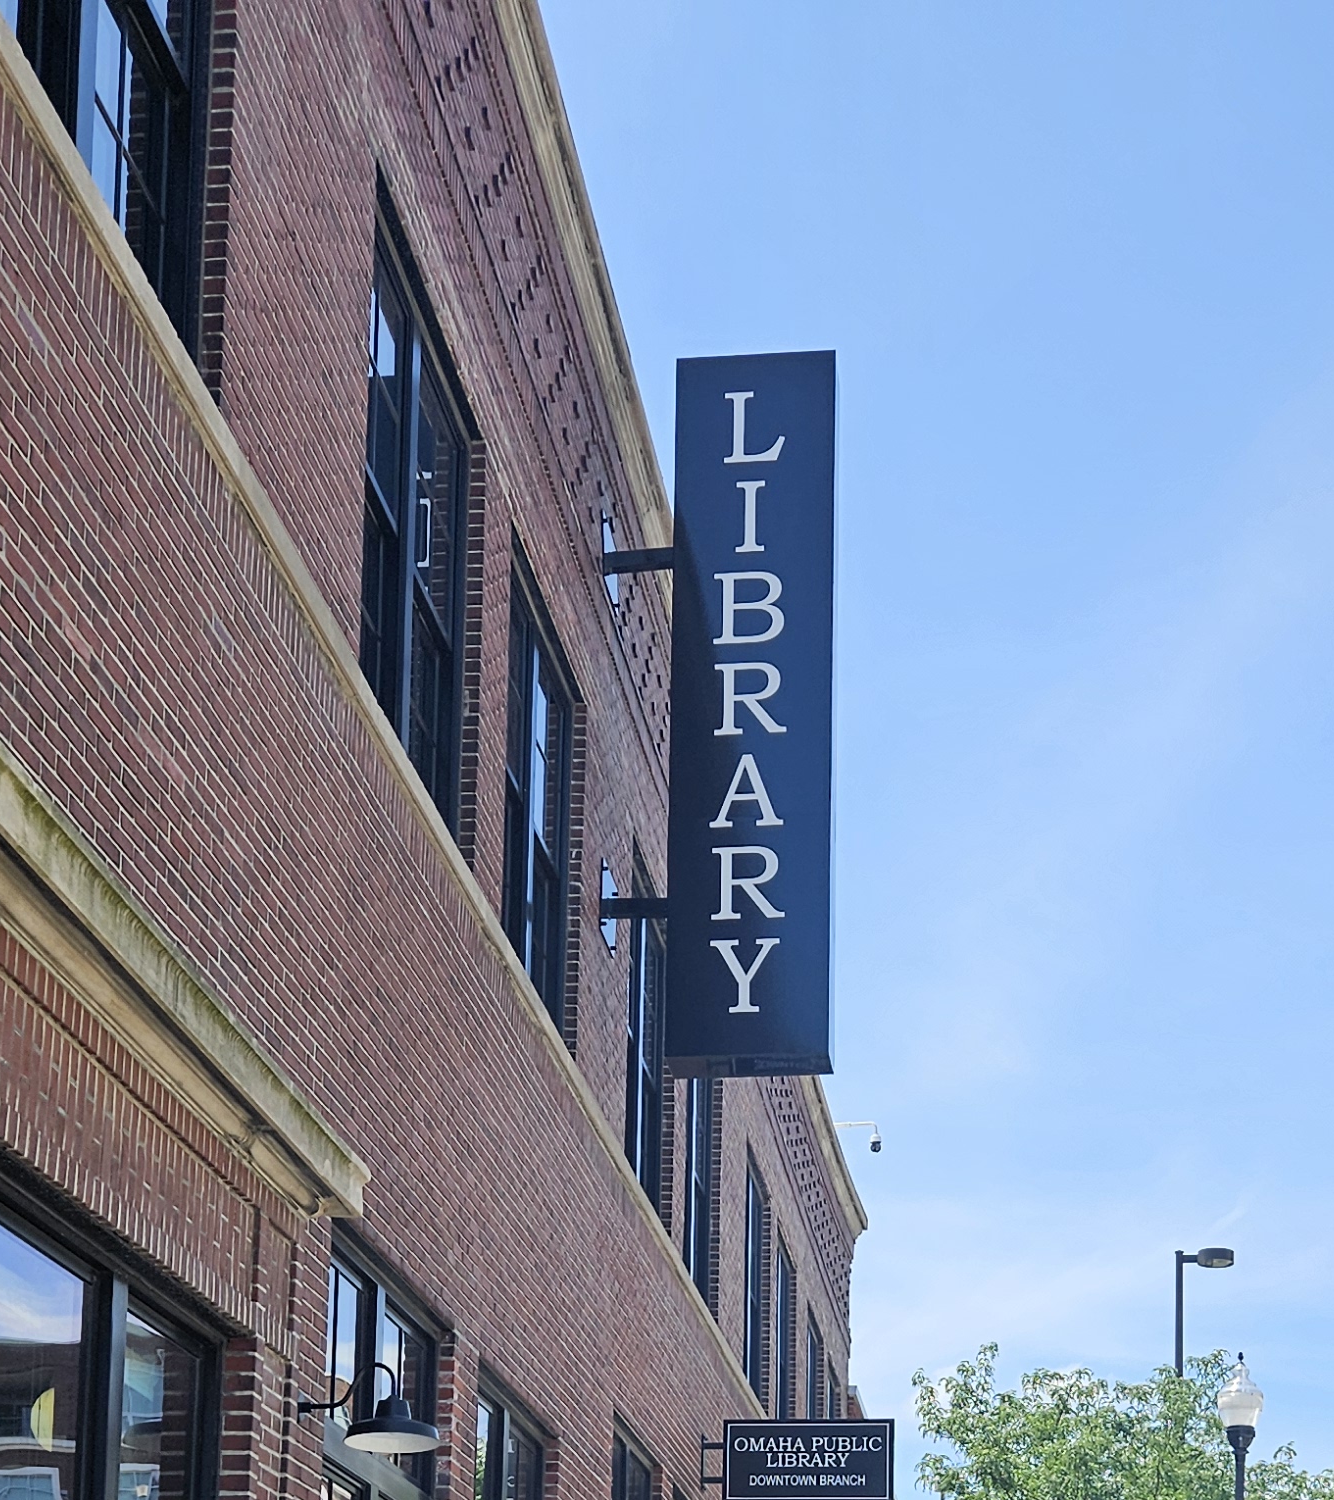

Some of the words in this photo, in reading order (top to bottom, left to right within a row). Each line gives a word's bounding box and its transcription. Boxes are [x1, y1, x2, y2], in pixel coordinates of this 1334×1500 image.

[709, 391, 788, 1017] LIBRARY
[733, 1436, 806, 1453] OMAHA
[811, 1436, 883, 1452] PUBLIC
[766, 1452, 850, 1468] LIBRARY
[749, 1474, 817, 1487] DOWNTOWN
[819, 1474, 866, 1487] BRANCH
